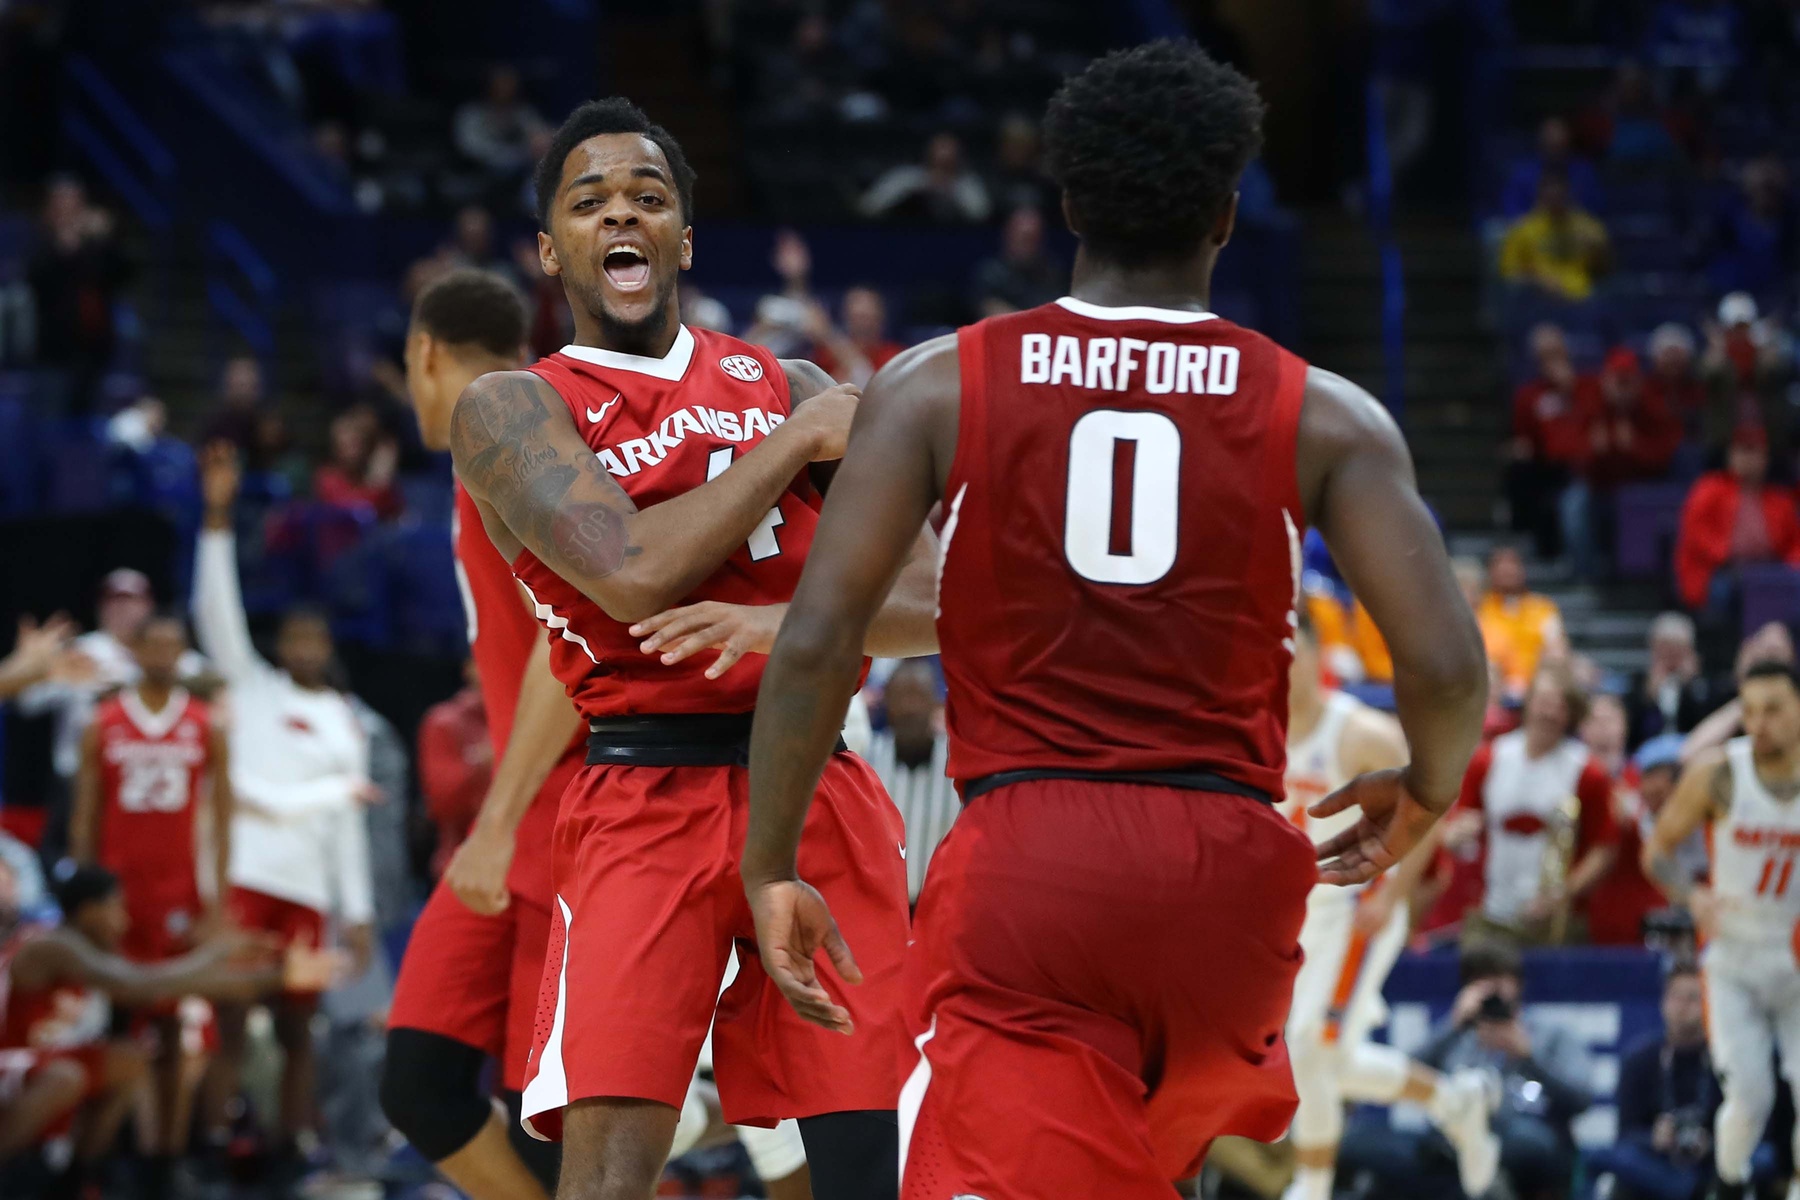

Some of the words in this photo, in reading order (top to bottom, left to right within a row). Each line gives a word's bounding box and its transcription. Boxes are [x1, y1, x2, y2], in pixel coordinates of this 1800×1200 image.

[720, 355, 763, 381] SEC
[1020, 333, 1240, 396] BARFORD
[1064, 408, 1181, 586] 0
[564, 509, 610, 570] STOP
[1756, 858, 1795, 898] 11
